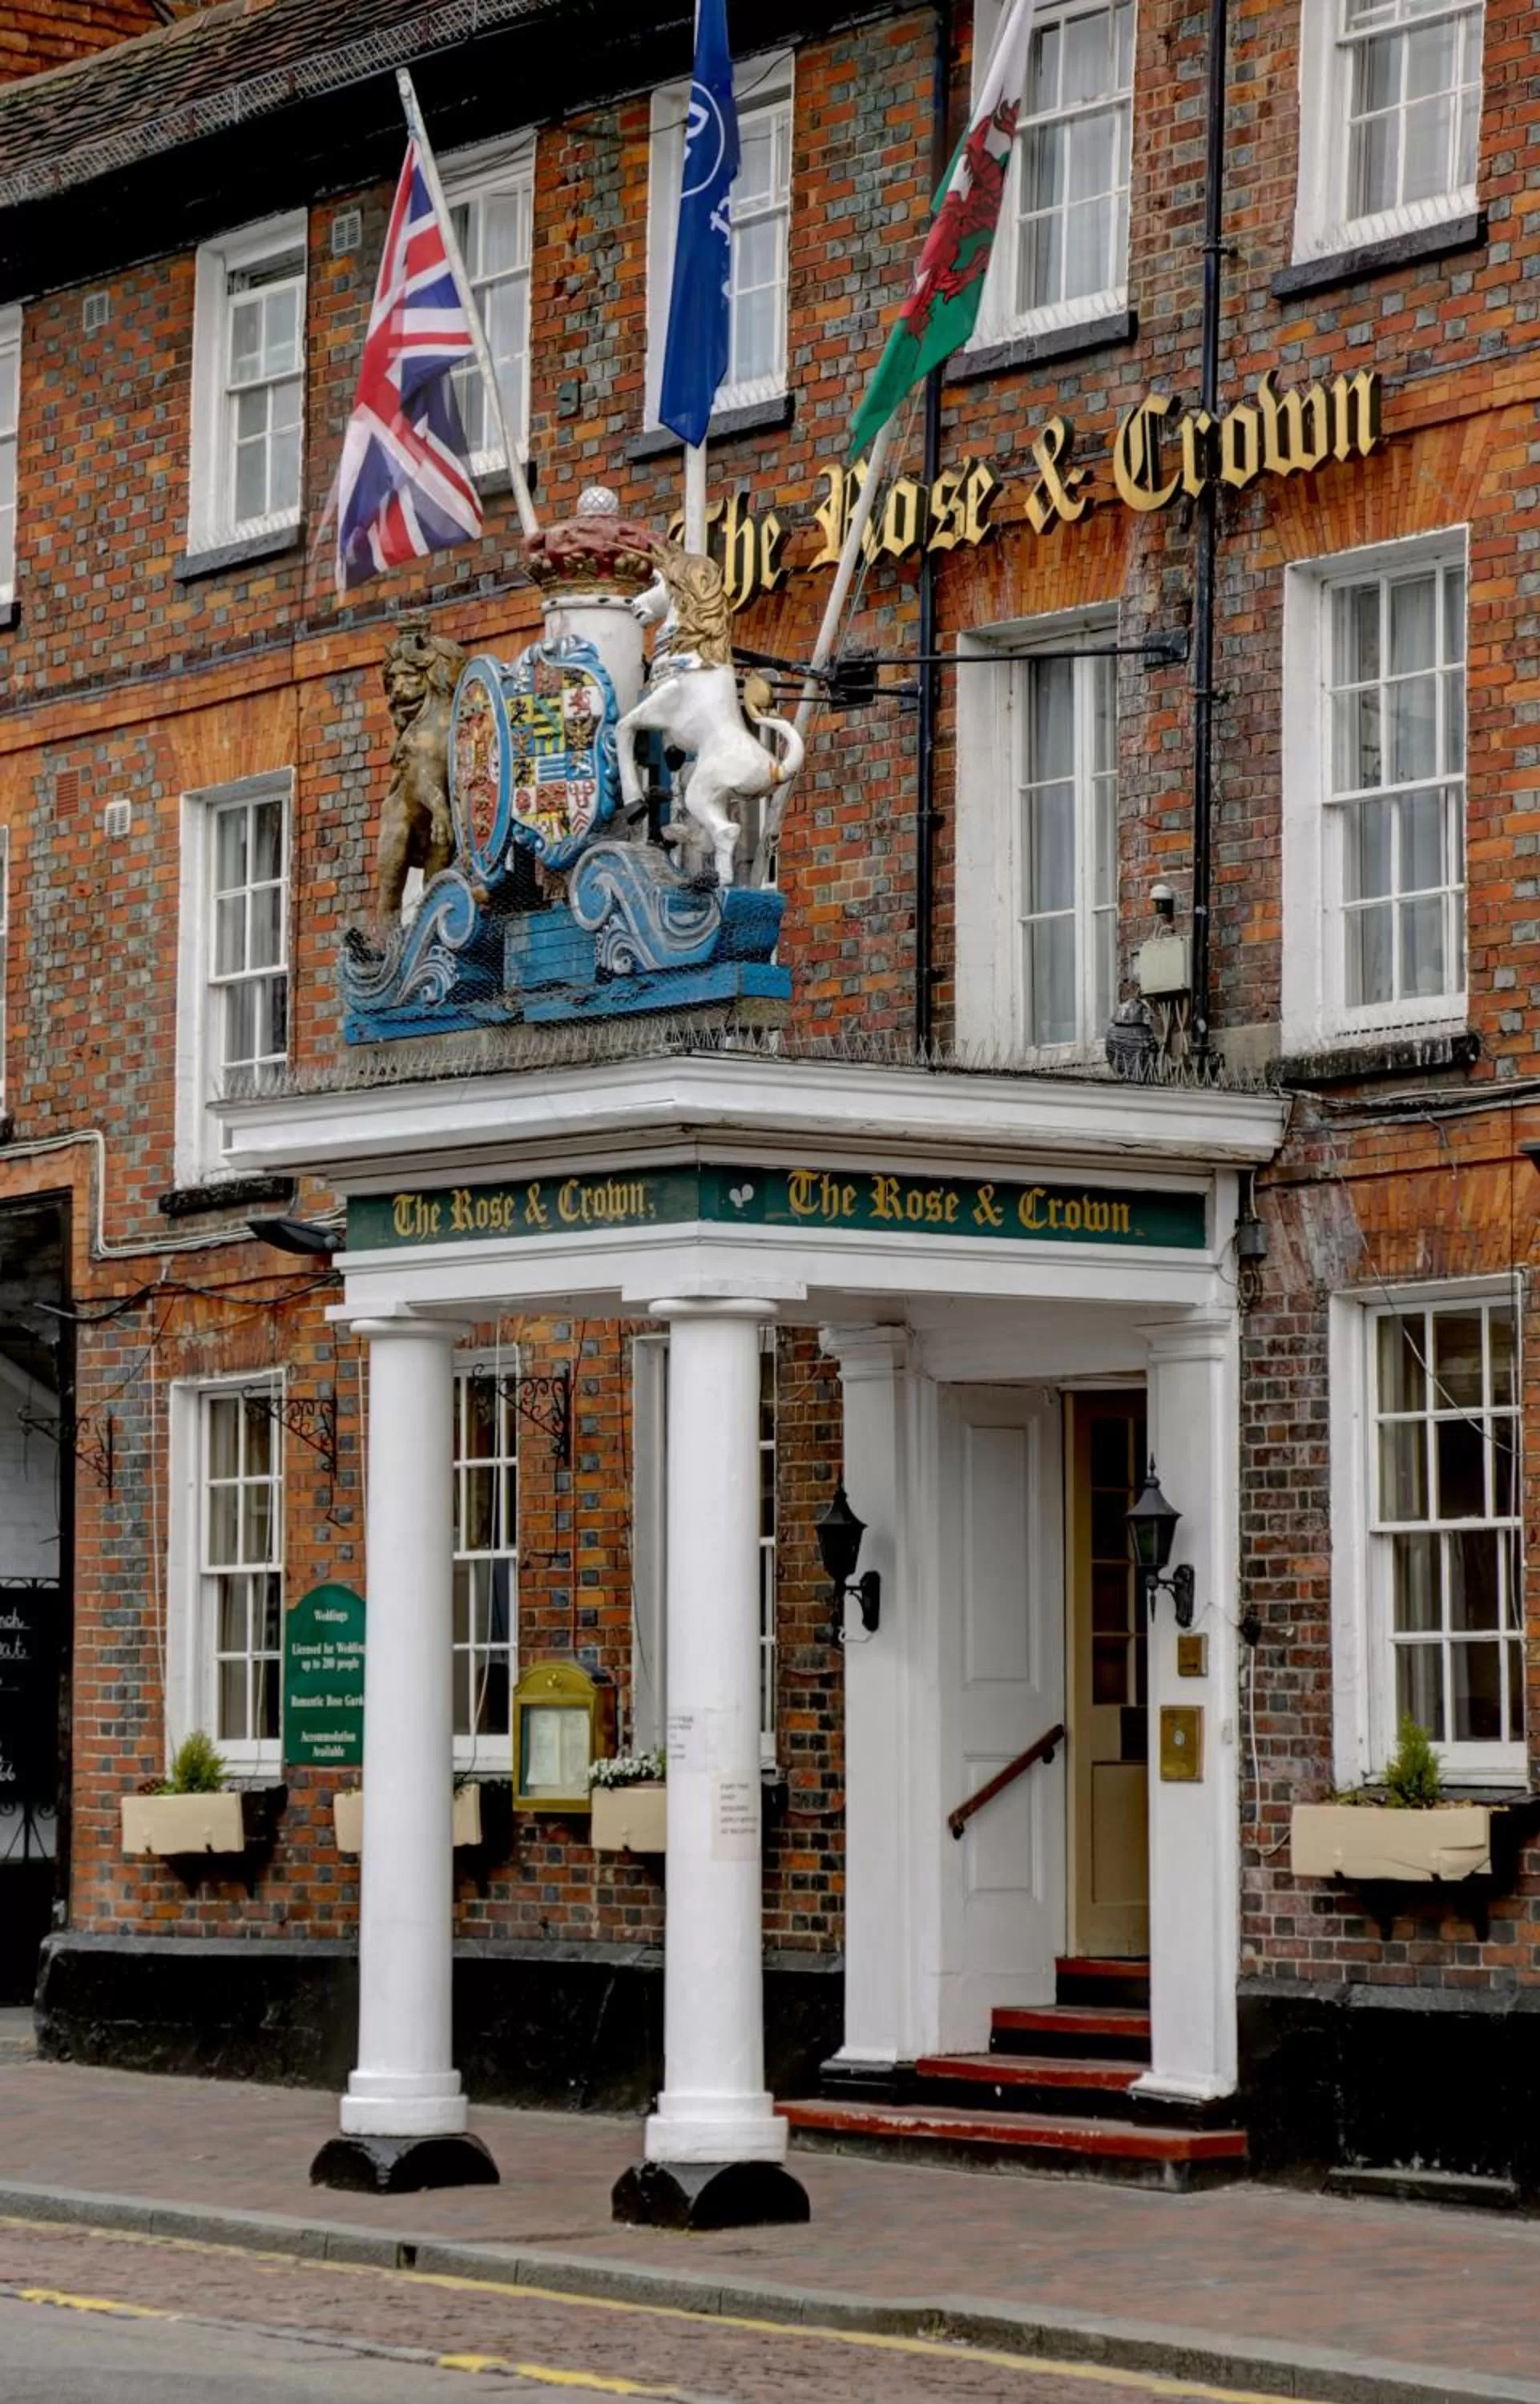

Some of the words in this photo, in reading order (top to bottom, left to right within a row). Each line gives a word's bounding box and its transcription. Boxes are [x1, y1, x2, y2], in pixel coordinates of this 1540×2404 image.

[1024, 416, 1093, 535] &
[1113, 369, 1385, 513] Crown
[393, 1192, 442, 1241] The
[450, 1188, 515, 1233] Rose
[524, 1182, 551, 1230] &
[788, 1168, 857, 1222] The
[869, 1175, 960, 1224] Rose
[973, 1180, 1004, 1225] &
[1018, 1187, 1132, 1234] Crown
[313, 1609, 349, 1623] Weddings
